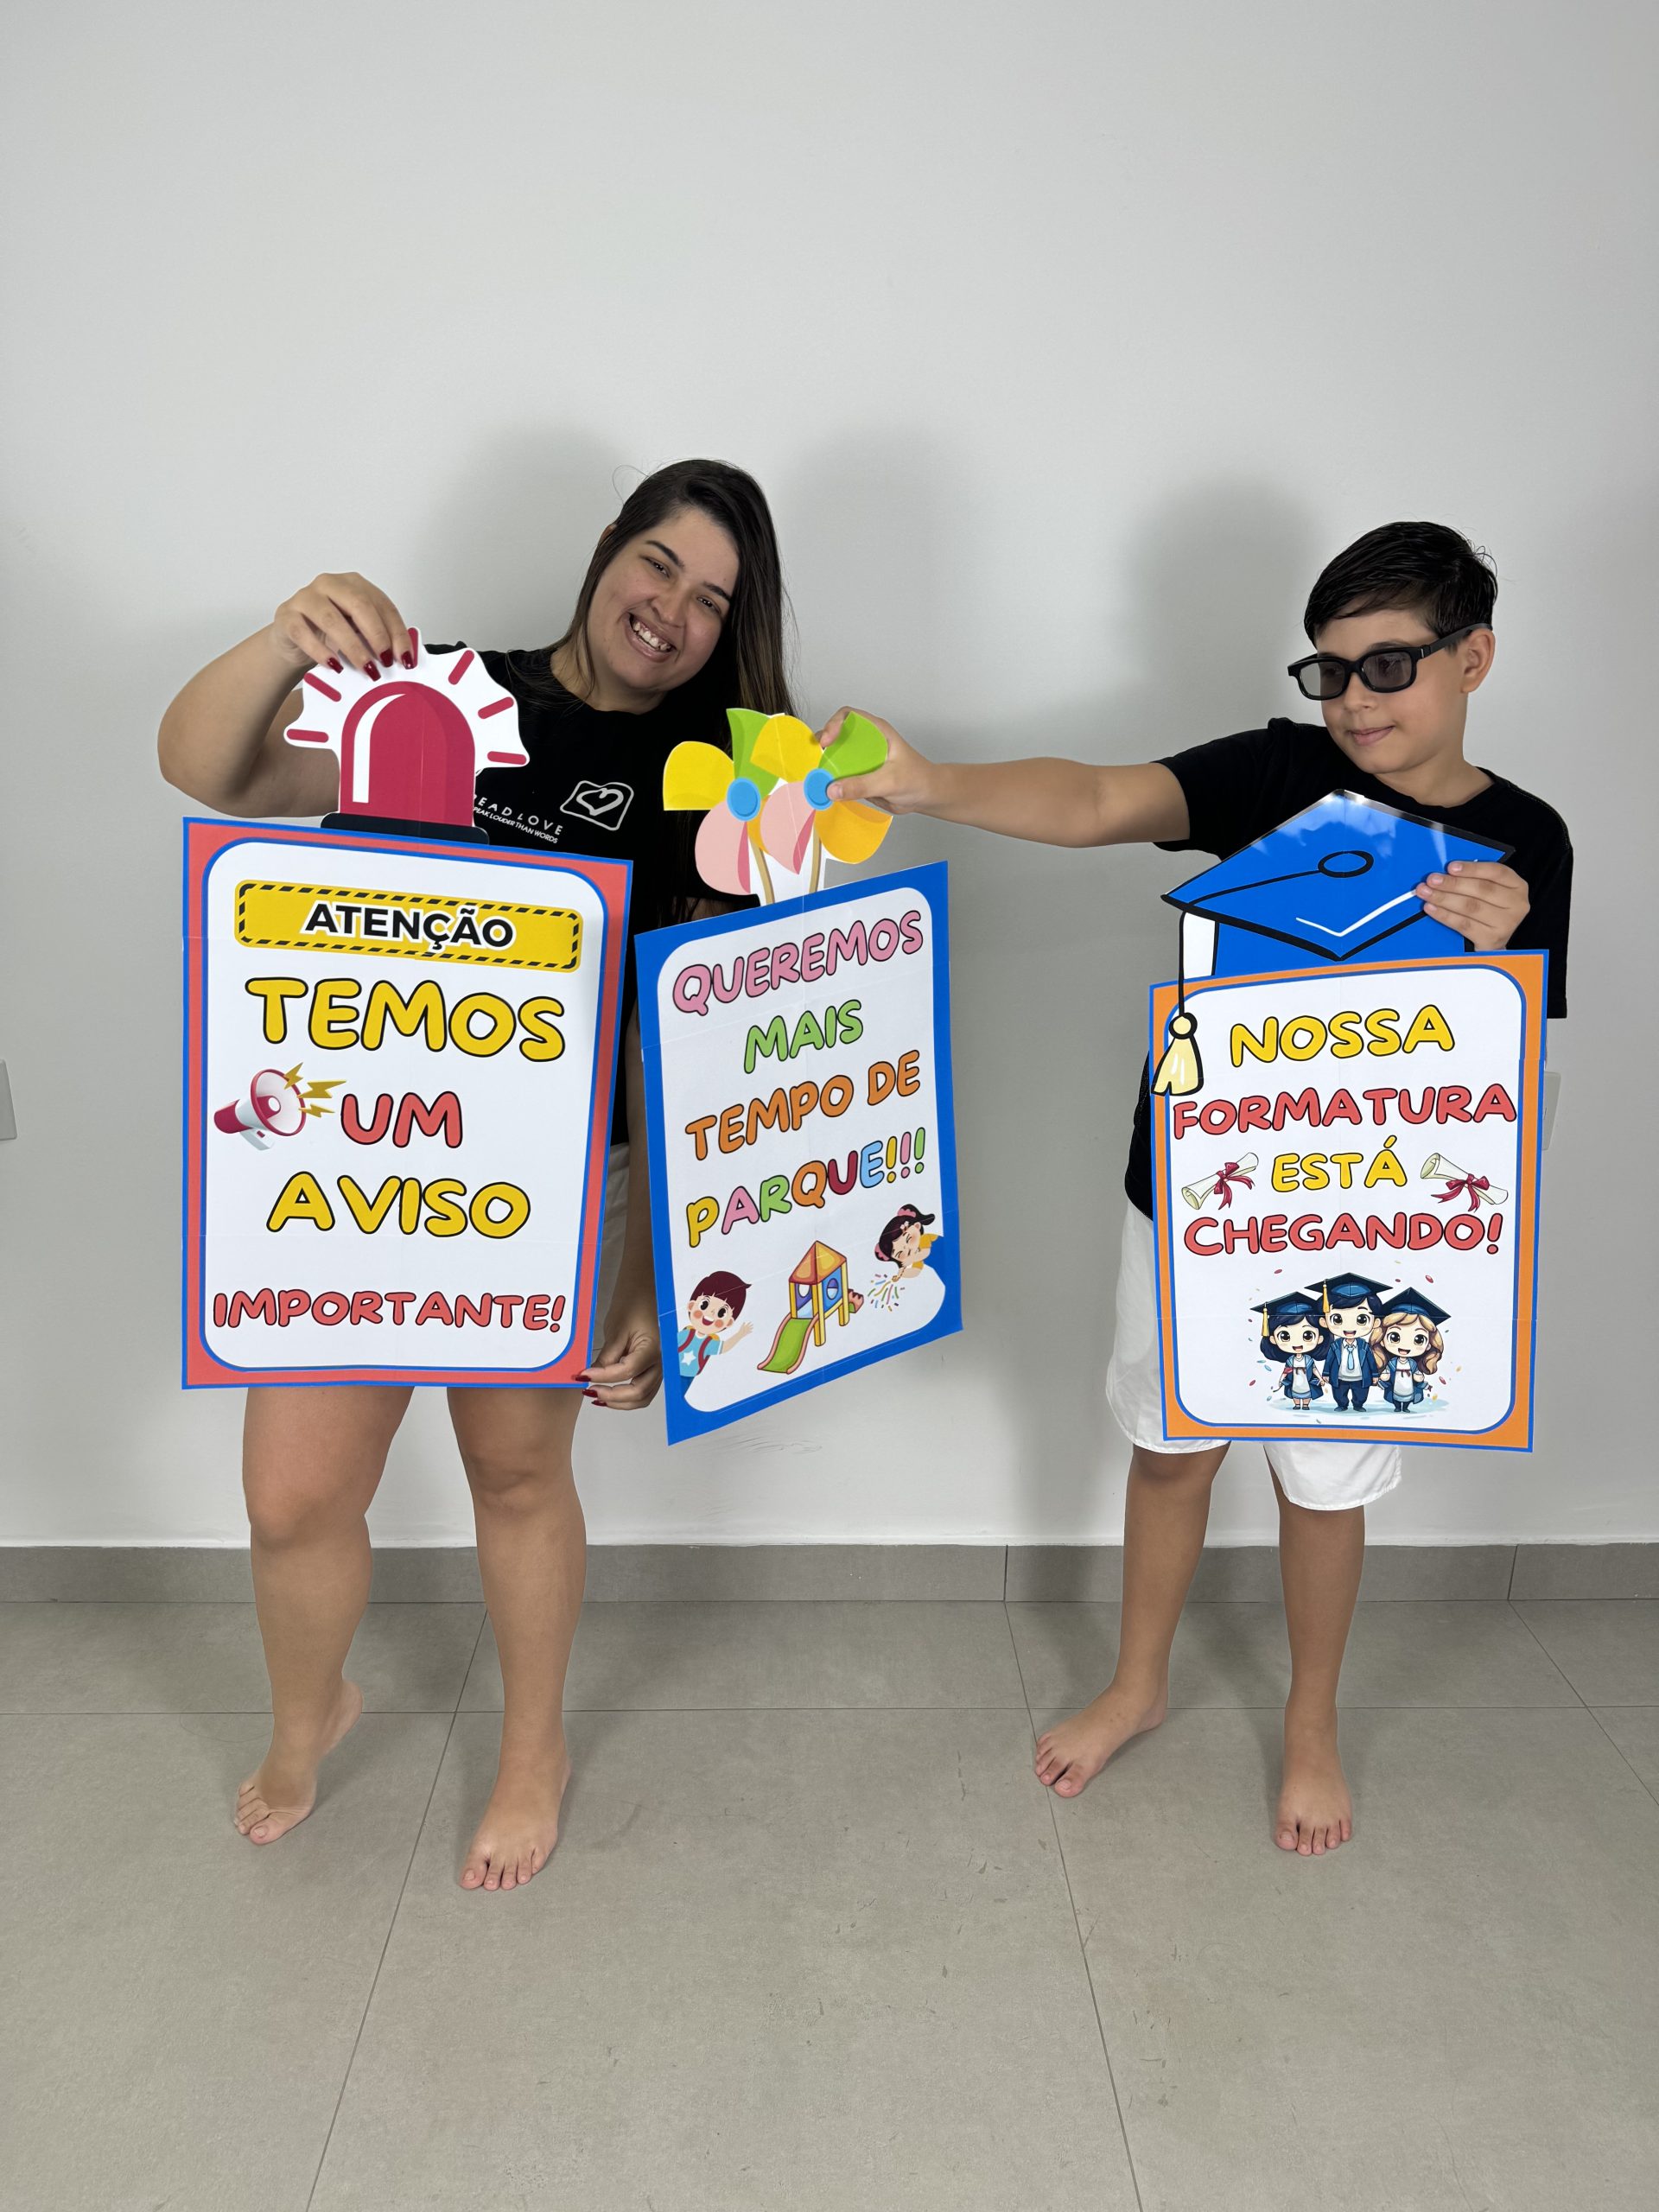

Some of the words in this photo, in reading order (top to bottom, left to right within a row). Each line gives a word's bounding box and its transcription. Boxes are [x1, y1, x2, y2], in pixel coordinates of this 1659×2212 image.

[489, 813, 516, 826] LOUDER
[515, 822, 534, 835] THAN
[534, 830, 558, 844] WORDS
[518, 813, 563, 836] LOVE
[306, 904, 512, 950] ATENÇÃO
[672, 910, 924, 1016] QUEREMOS
[245, 977, 565, 1062] TEMOS
[744, 1000, 863, 1074] MAIS
[1230, 1005, 1455, 1067] NOSSA
[340, 1091, 462, 1148] UM
[685, 1080, 854, 1161] TEMPO
[868, 1050, 920, 1105] DE
[1173, 1084, 1517, 1140] FORMATURA
[685, 1128, 926, 1248] PARQUE!!!
[1271, 1135, 1408, 1192] ESTÁ
[266, 1172, 531, 1239] AVISO
[1185, 1212, 1503, 1255] CHEGANDO!
[213, 1288, 565, 1332] IMPORTANTE!
